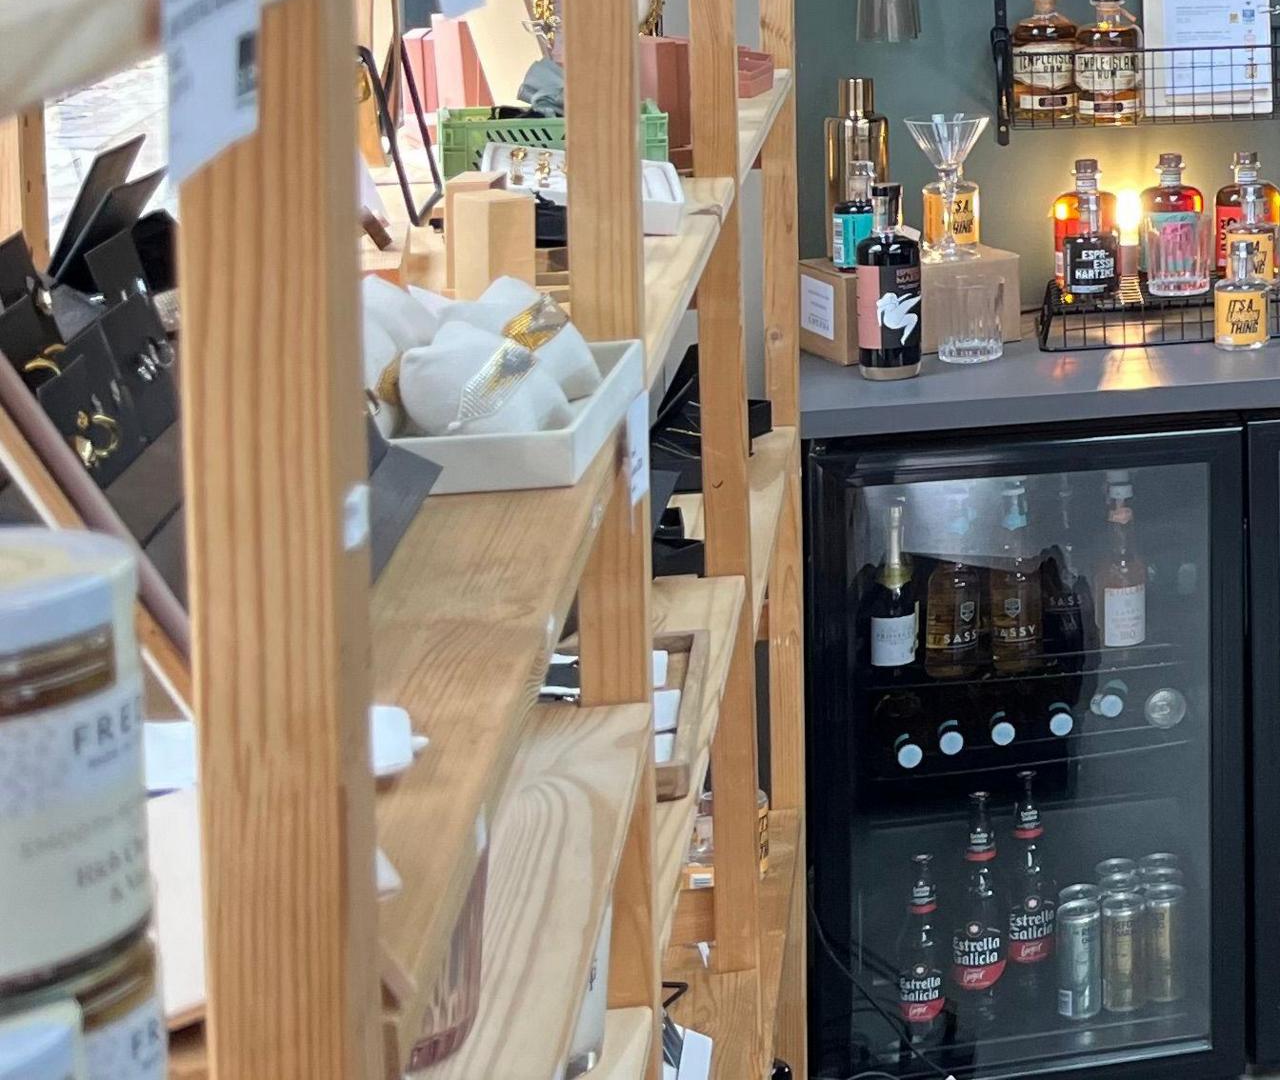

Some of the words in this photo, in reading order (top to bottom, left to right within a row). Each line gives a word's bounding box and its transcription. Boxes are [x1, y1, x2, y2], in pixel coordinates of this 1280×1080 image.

[1075, 268, 1115, 280] MARTINI
[1230, 320, 1258, 334] THING
[944, 630, 978, 644] SASS
[72, 696, 143, 757] FRE
[1009, 909, 1055, 928] Estrella
[1009, 923, 1054, 941] Galicia
[952, 936, 1000, 952] Estrella
[953, 950, 999, 966] Galicia
[900, 975, 942, 991] Estrella
[900, 987, 940, 1002] Galicia
